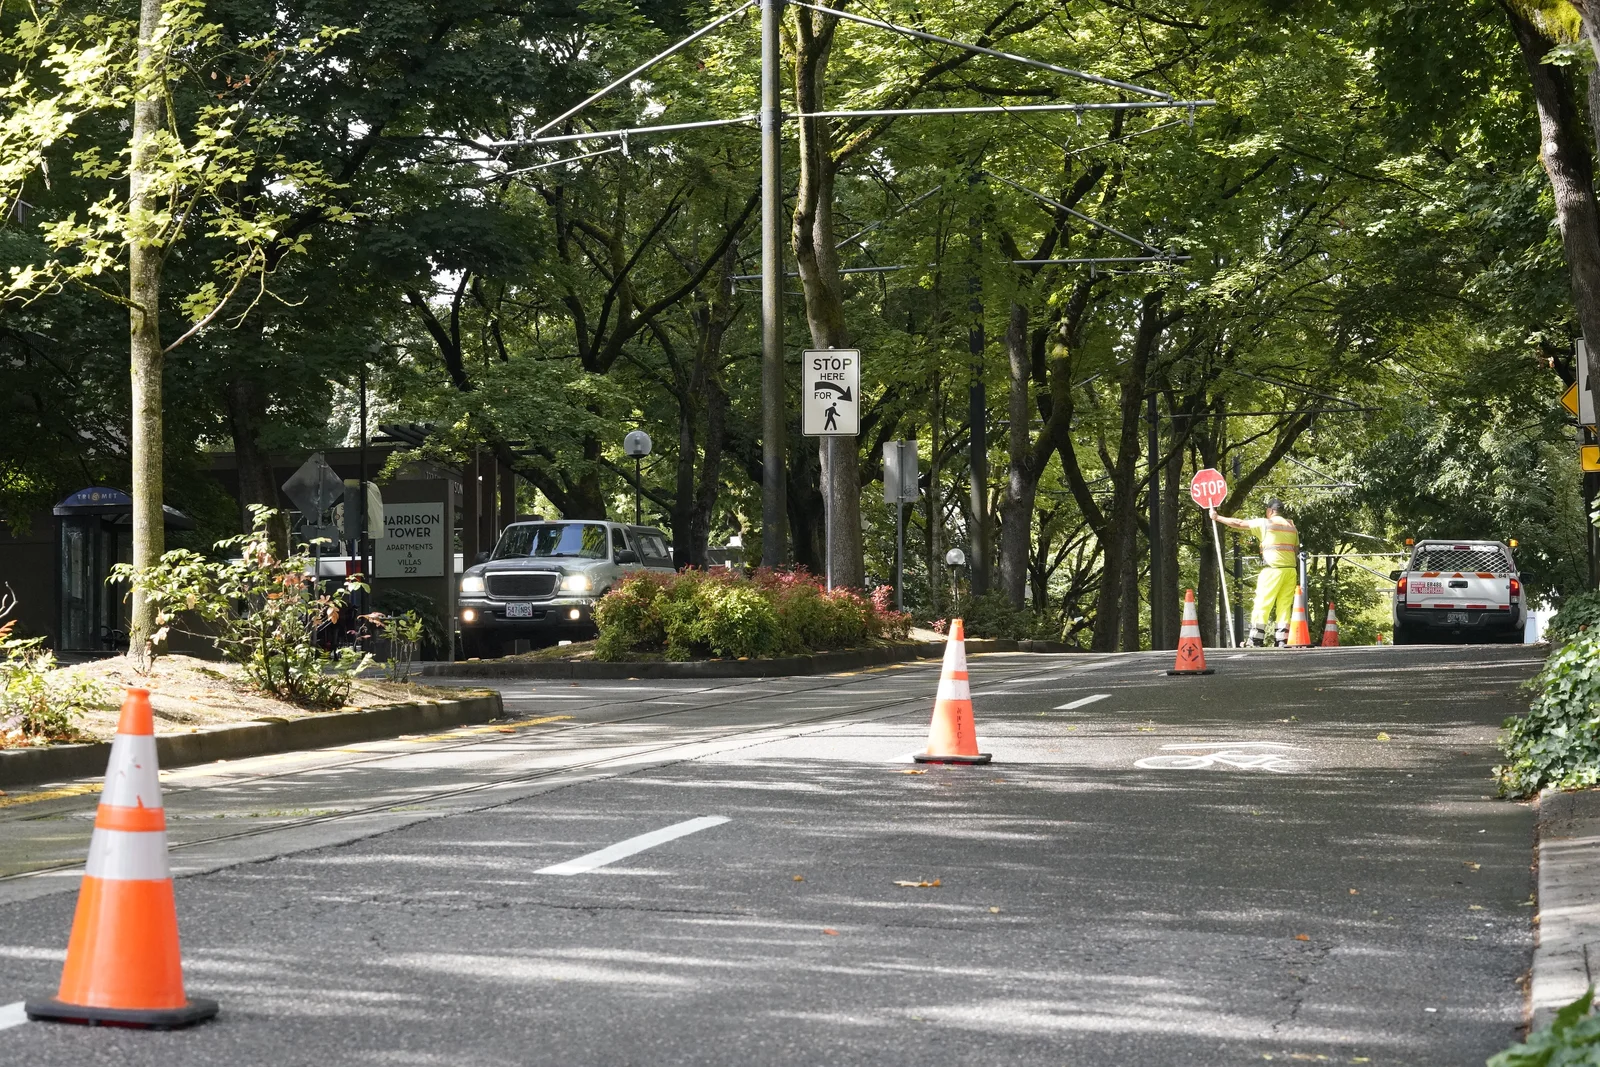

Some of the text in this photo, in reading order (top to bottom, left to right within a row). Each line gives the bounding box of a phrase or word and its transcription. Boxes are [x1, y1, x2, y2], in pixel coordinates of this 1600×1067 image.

[813, 358, 852, 370] STOP
[820, 372, 845, 381] HERE
[814, 391, 832, 400] FOR
[1193, 480, 1225, 498] STOP
[388, 527, 431, 538] TOWER
[386, 543, 434, 551] APARTMENTS
[404, 566, 417, 574] 222
